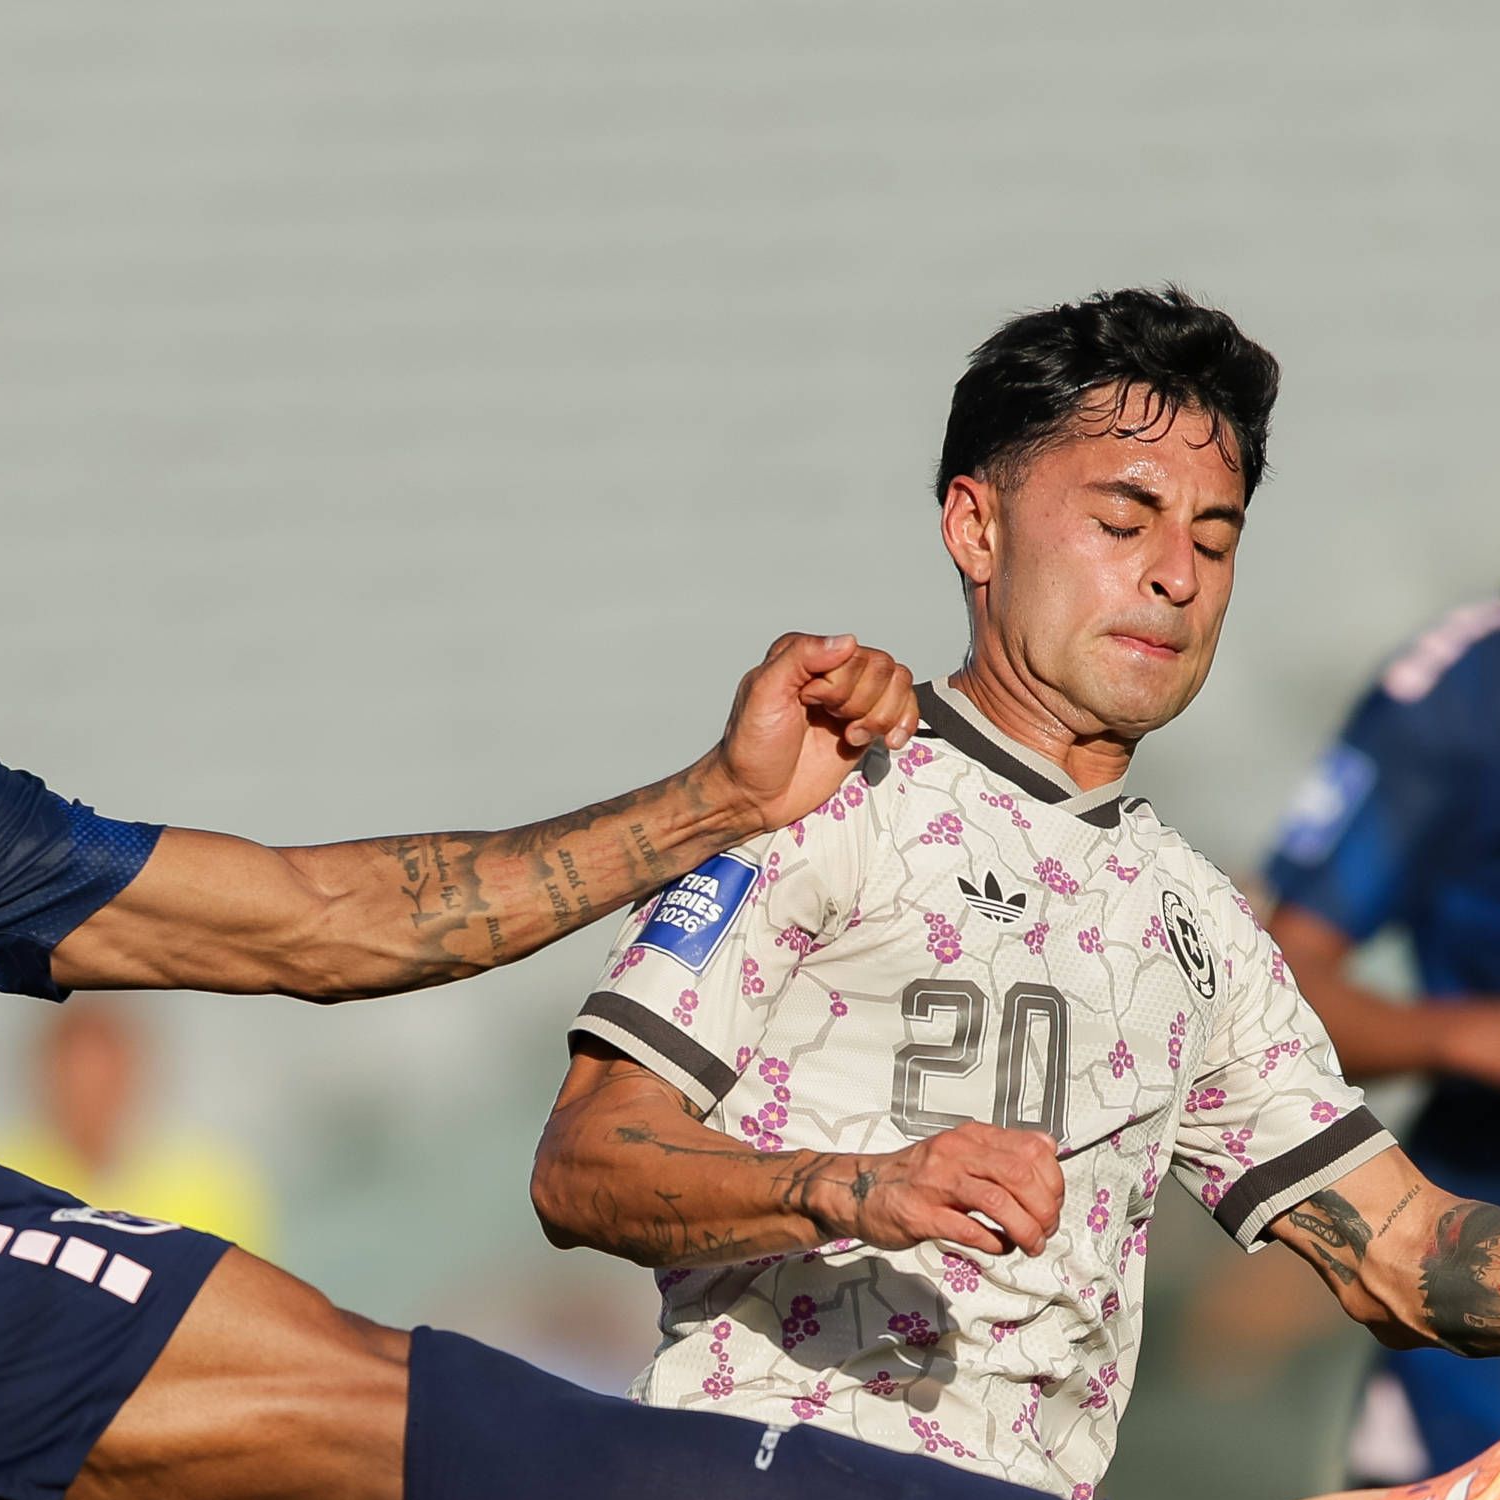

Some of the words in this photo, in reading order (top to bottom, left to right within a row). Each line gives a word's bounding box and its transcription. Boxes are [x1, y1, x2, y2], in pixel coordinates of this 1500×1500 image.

[557, 848, 587, 890] your
[678, 873, 720, 900] FIFA
[654, 906, 701, 934] 2026
[661, 889, 725, 923] SERIES
[890, 978, 1072, 1146] 20
[754, 1424, 791, 1472] ca
